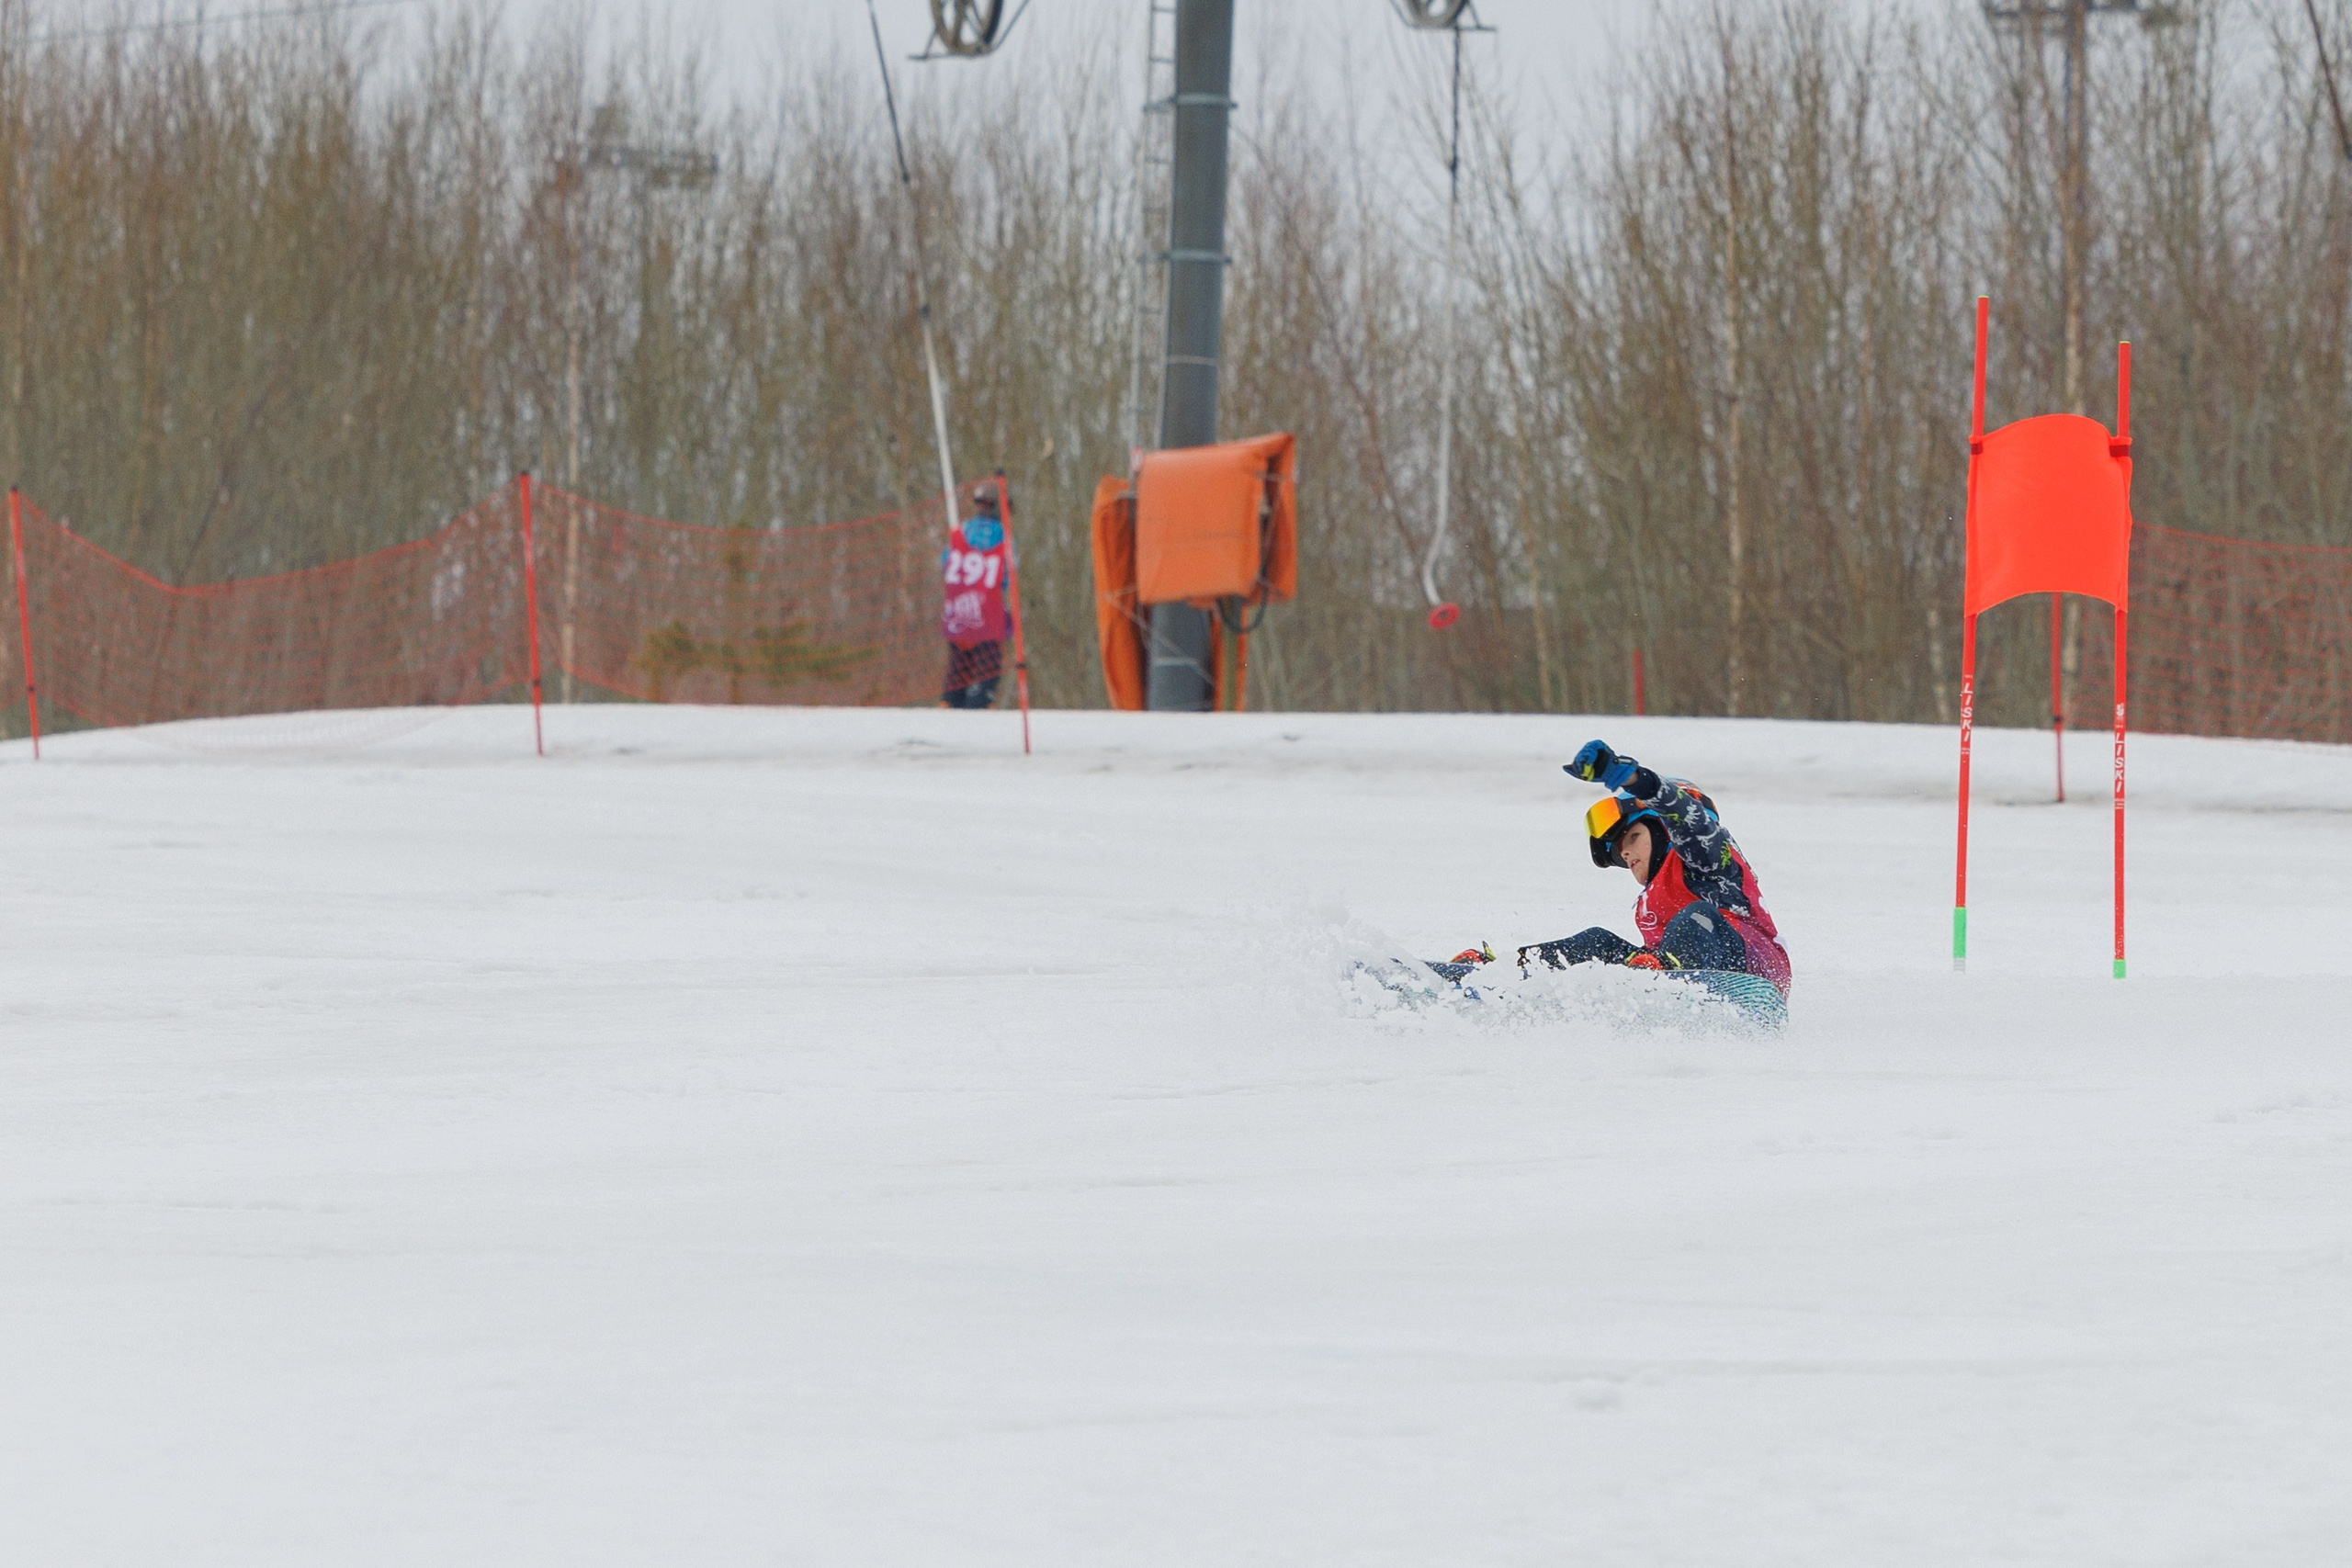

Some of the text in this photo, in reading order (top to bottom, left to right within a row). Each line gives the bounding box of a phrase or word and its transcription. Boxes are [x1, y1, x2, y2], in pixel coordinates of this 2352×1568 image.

[944, 549, 1000, 589] 291
[1962, 682, 1973, 742] LISKI
[2114, 732, 2125, 794] LISKI
